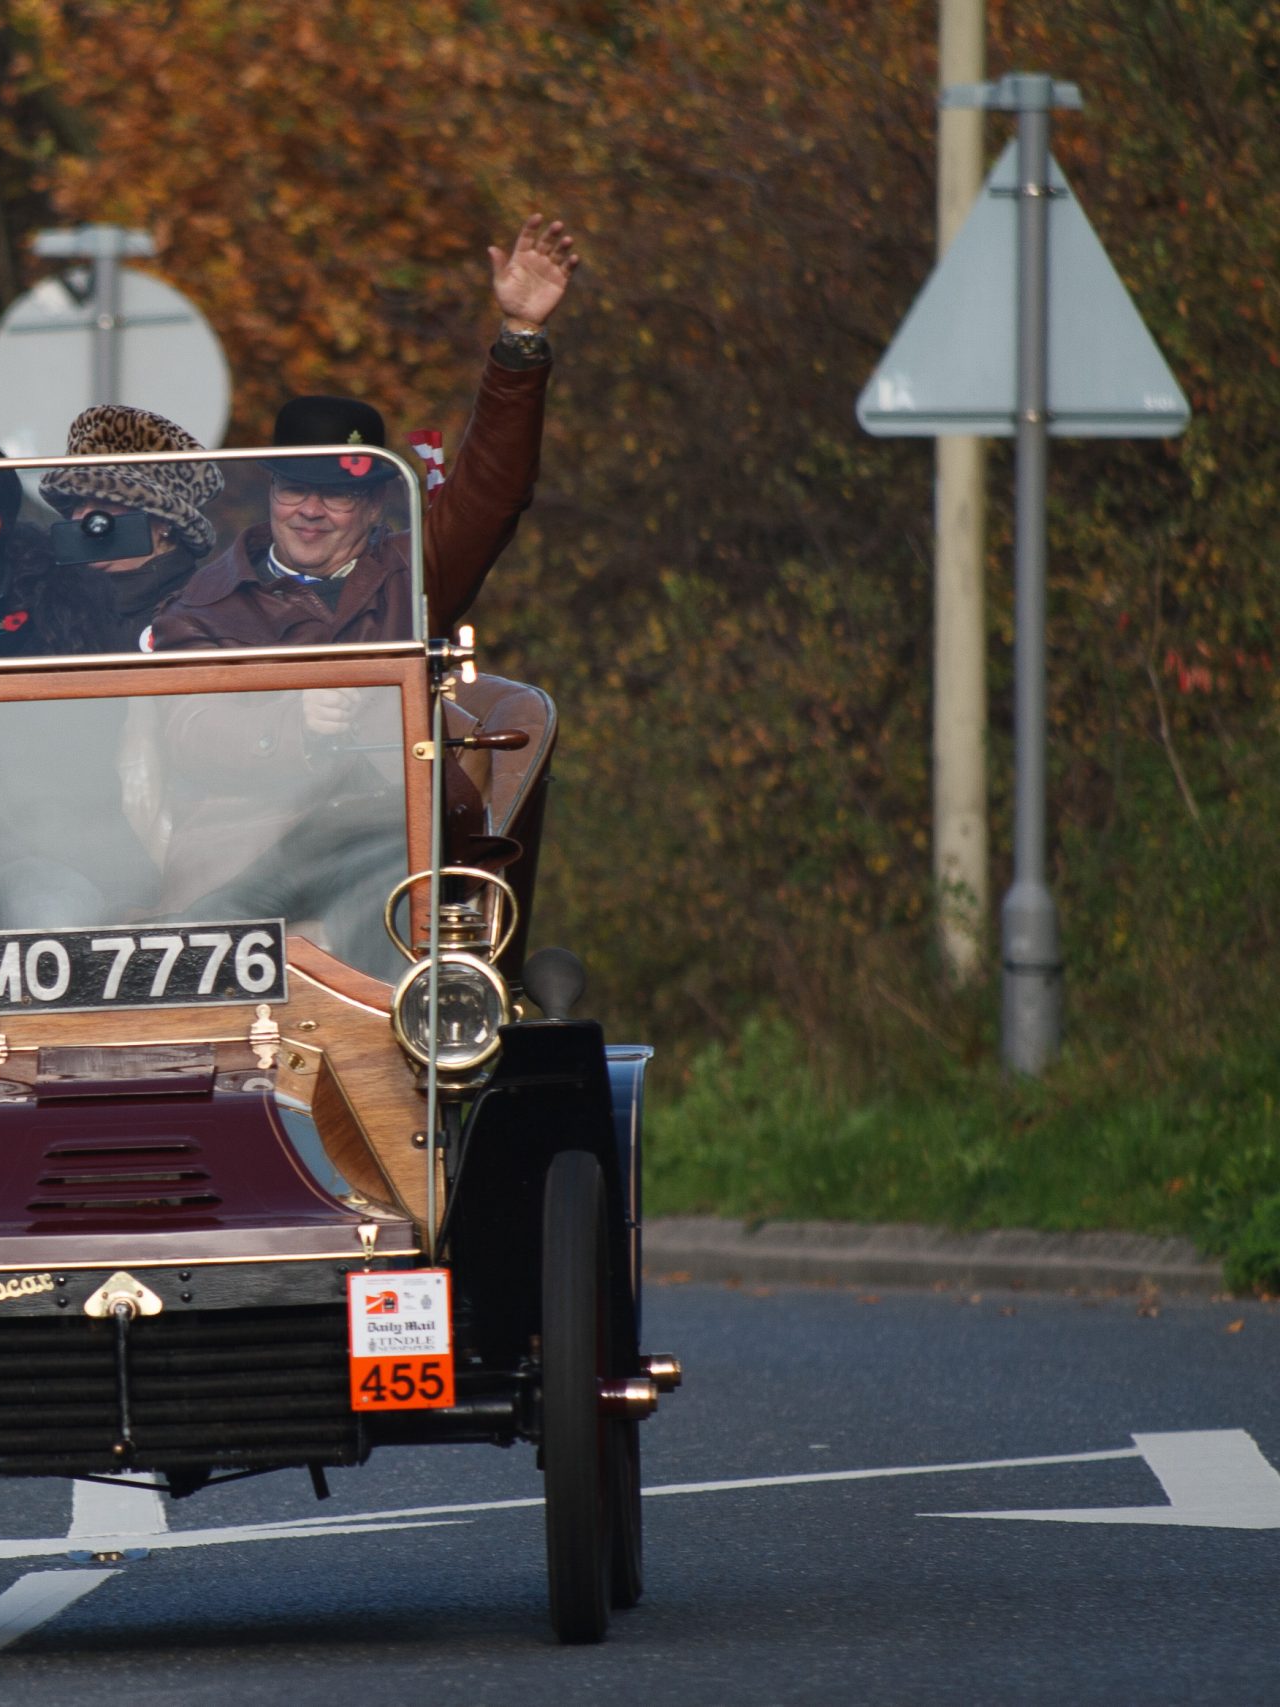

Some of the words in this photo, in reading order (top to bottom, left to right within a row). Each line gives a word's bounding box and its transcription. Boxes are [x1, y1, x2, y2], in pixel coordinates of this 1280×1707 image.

[91, 930, 276, 999] 7776
[367, 1321, 402, 1334] Daily
[405, 1320, 436, 1331] Mail
[379, 1335, 434, 1345] TINDLE
[360, 1361, 444, 1402] 455
